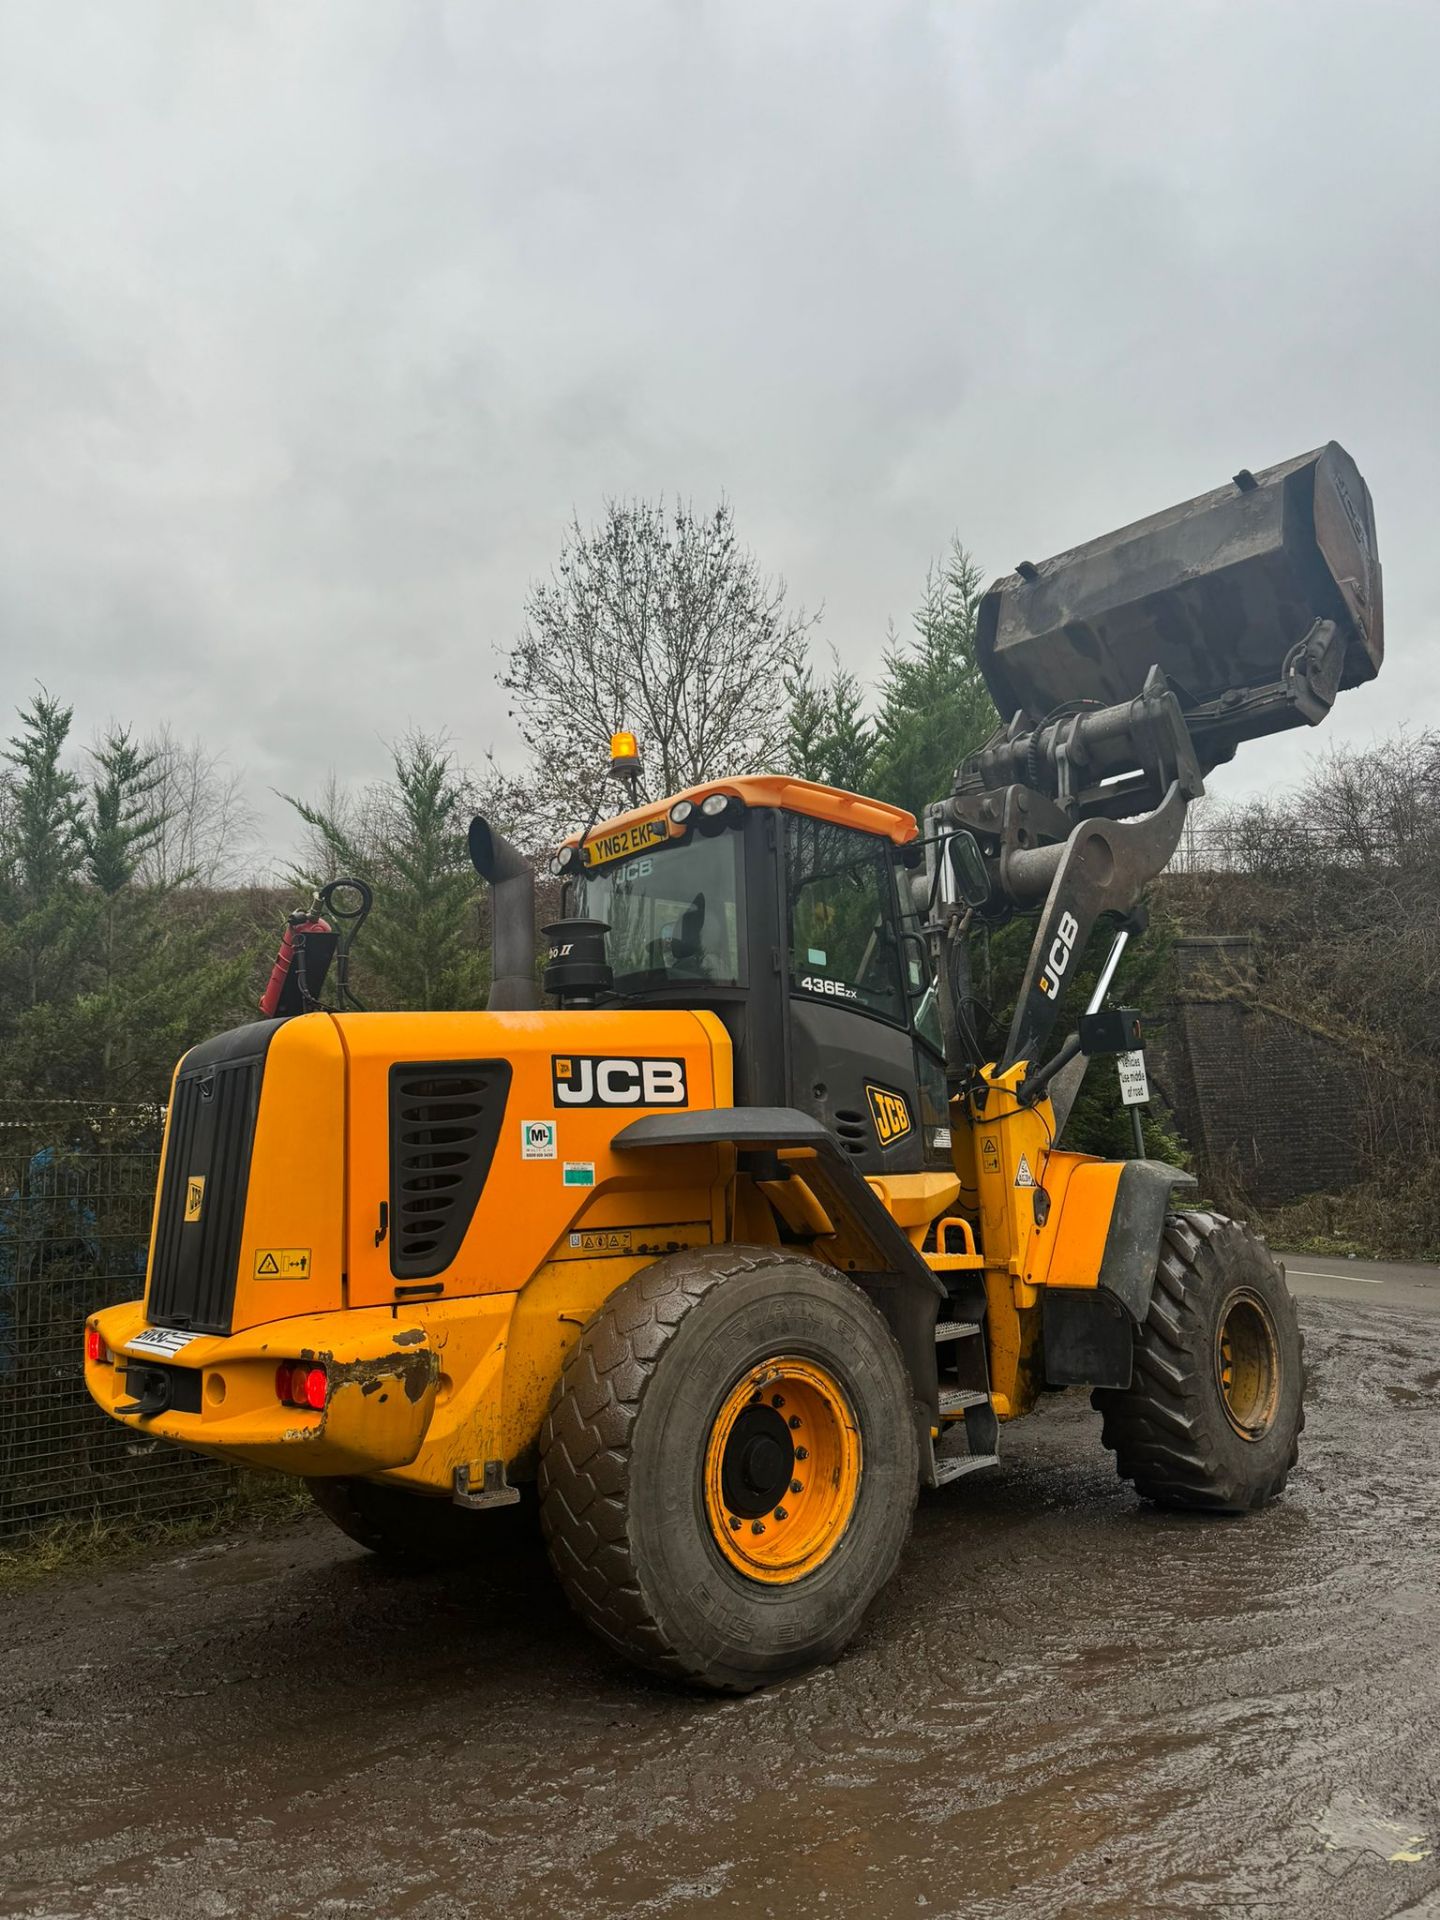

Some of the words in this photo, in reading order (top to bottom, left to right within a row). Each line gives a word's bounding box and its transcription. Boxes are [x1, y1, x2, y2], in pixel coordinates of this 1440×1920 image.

[596, 832, 629, 859] YN62
[616, 858, 653, 884] JCB
[1044, 911, 1079, 1000] JCB
[557, 1060, 685, 1103] JCB
[874, 1092, 908, 1138] JCB
